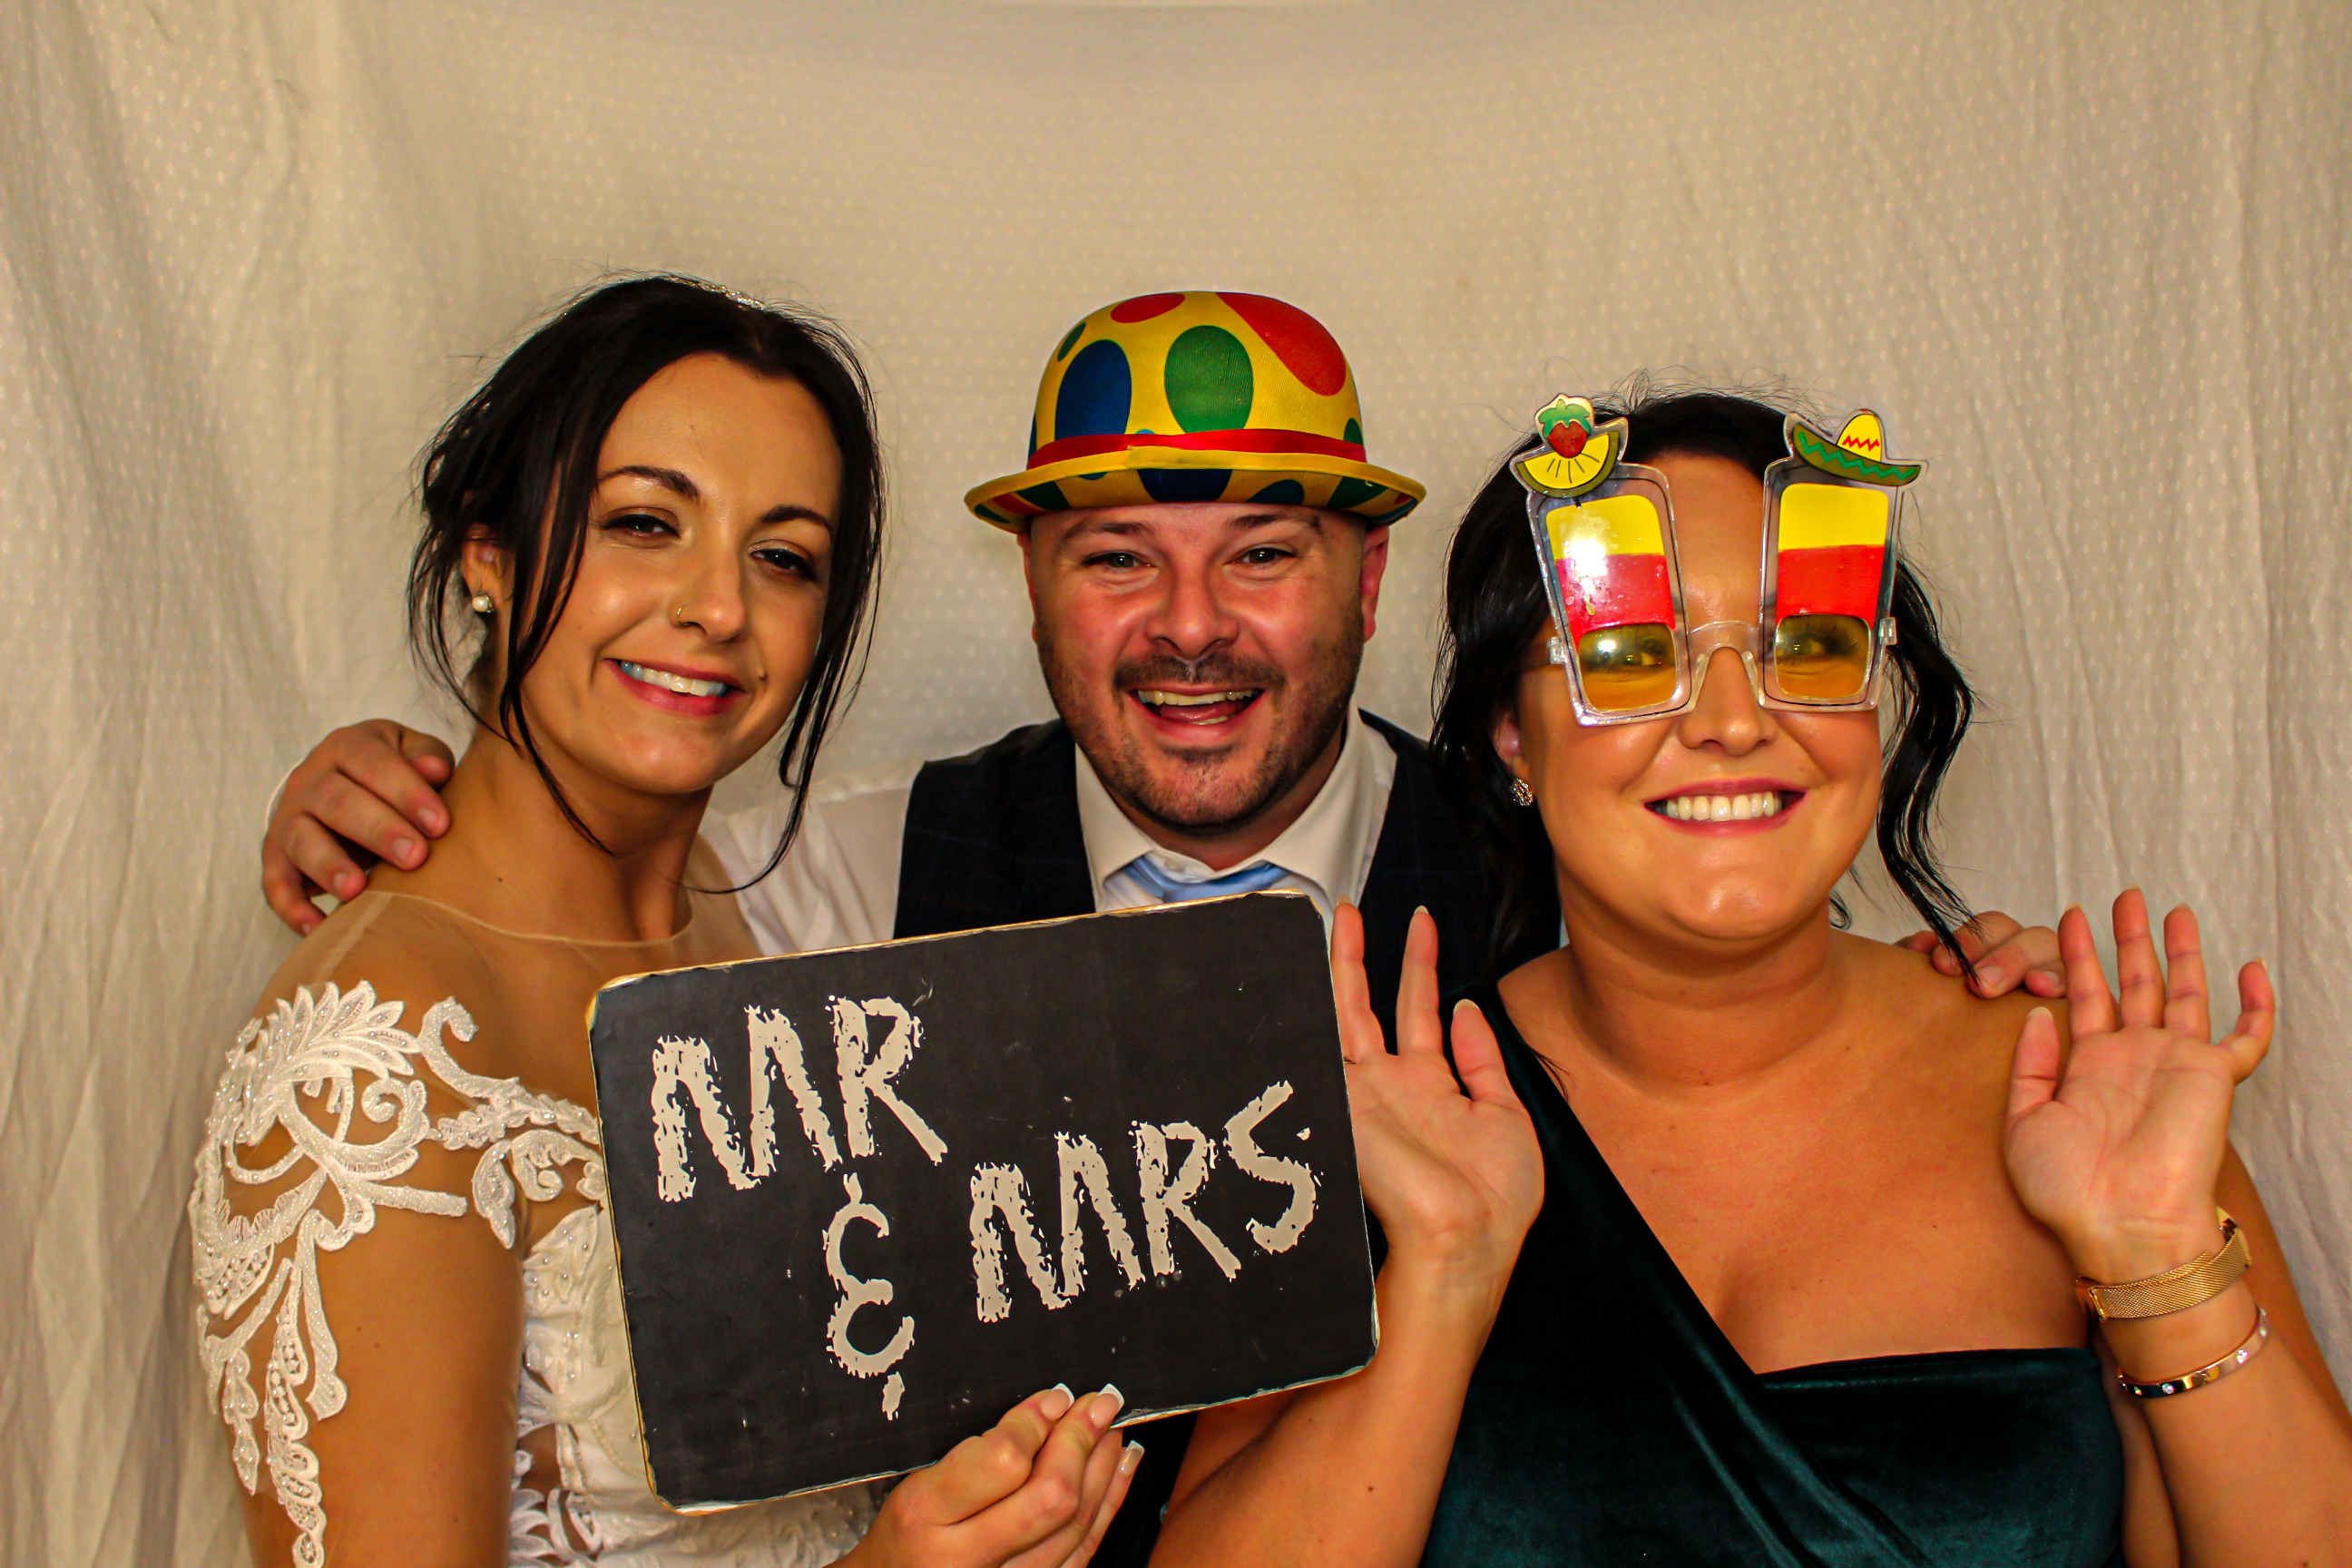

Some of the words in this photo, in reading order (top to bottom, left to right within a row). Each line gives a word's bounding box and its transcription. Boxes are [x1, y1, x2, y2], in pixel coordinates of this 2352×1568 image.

[651, 995, 948, 1202] MR
[969, 1081, 1321, 1323] MRS
[823, 1172, 915, 1420] &
